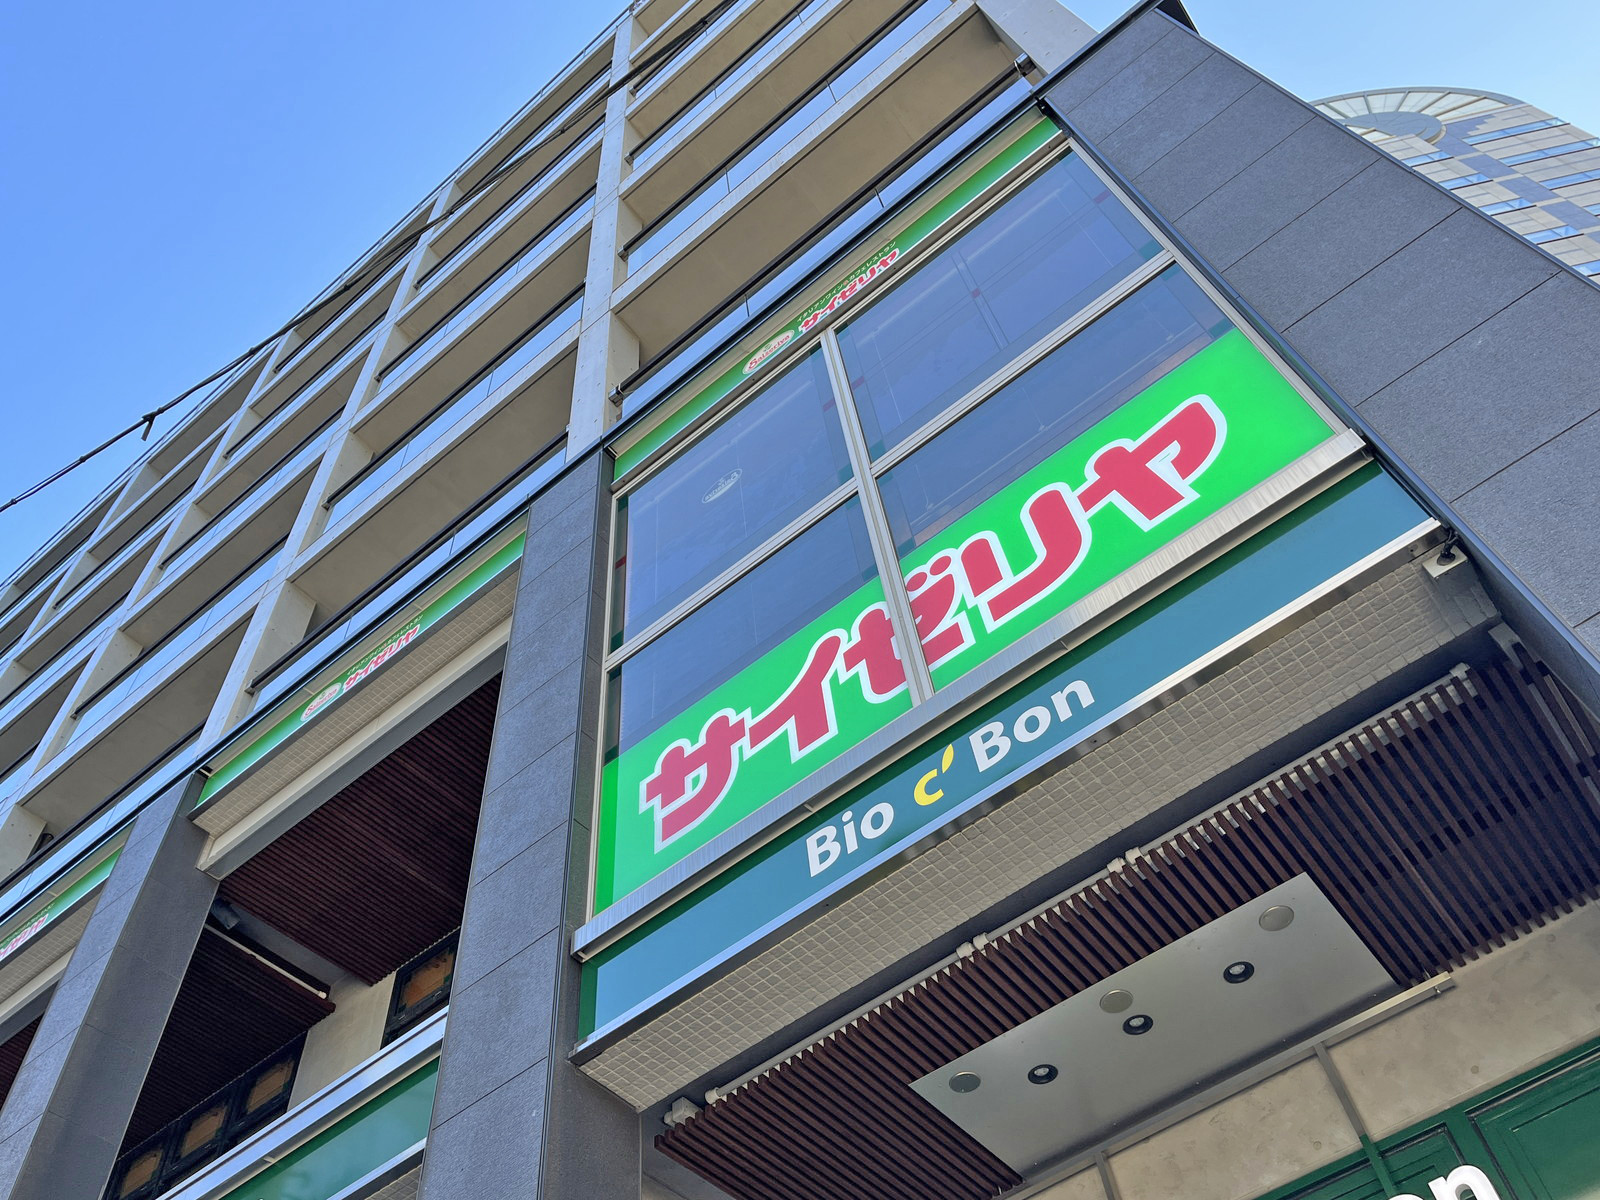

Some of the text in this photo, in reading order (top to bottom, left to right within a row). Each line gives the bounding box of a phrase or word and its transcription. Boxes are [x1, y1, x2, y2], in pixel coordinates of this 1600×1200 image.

[798, 247, 900, 334] サイゼリヤ
[748, 333, 791, 371] Saizeriya
[342, 624, 421, 694] サイゼリヤ
[640, 394, 1227, 854] サイゼリヤ
[805, 801, 895, 878] Bio
[967, 679, 1096, 773] Bon
